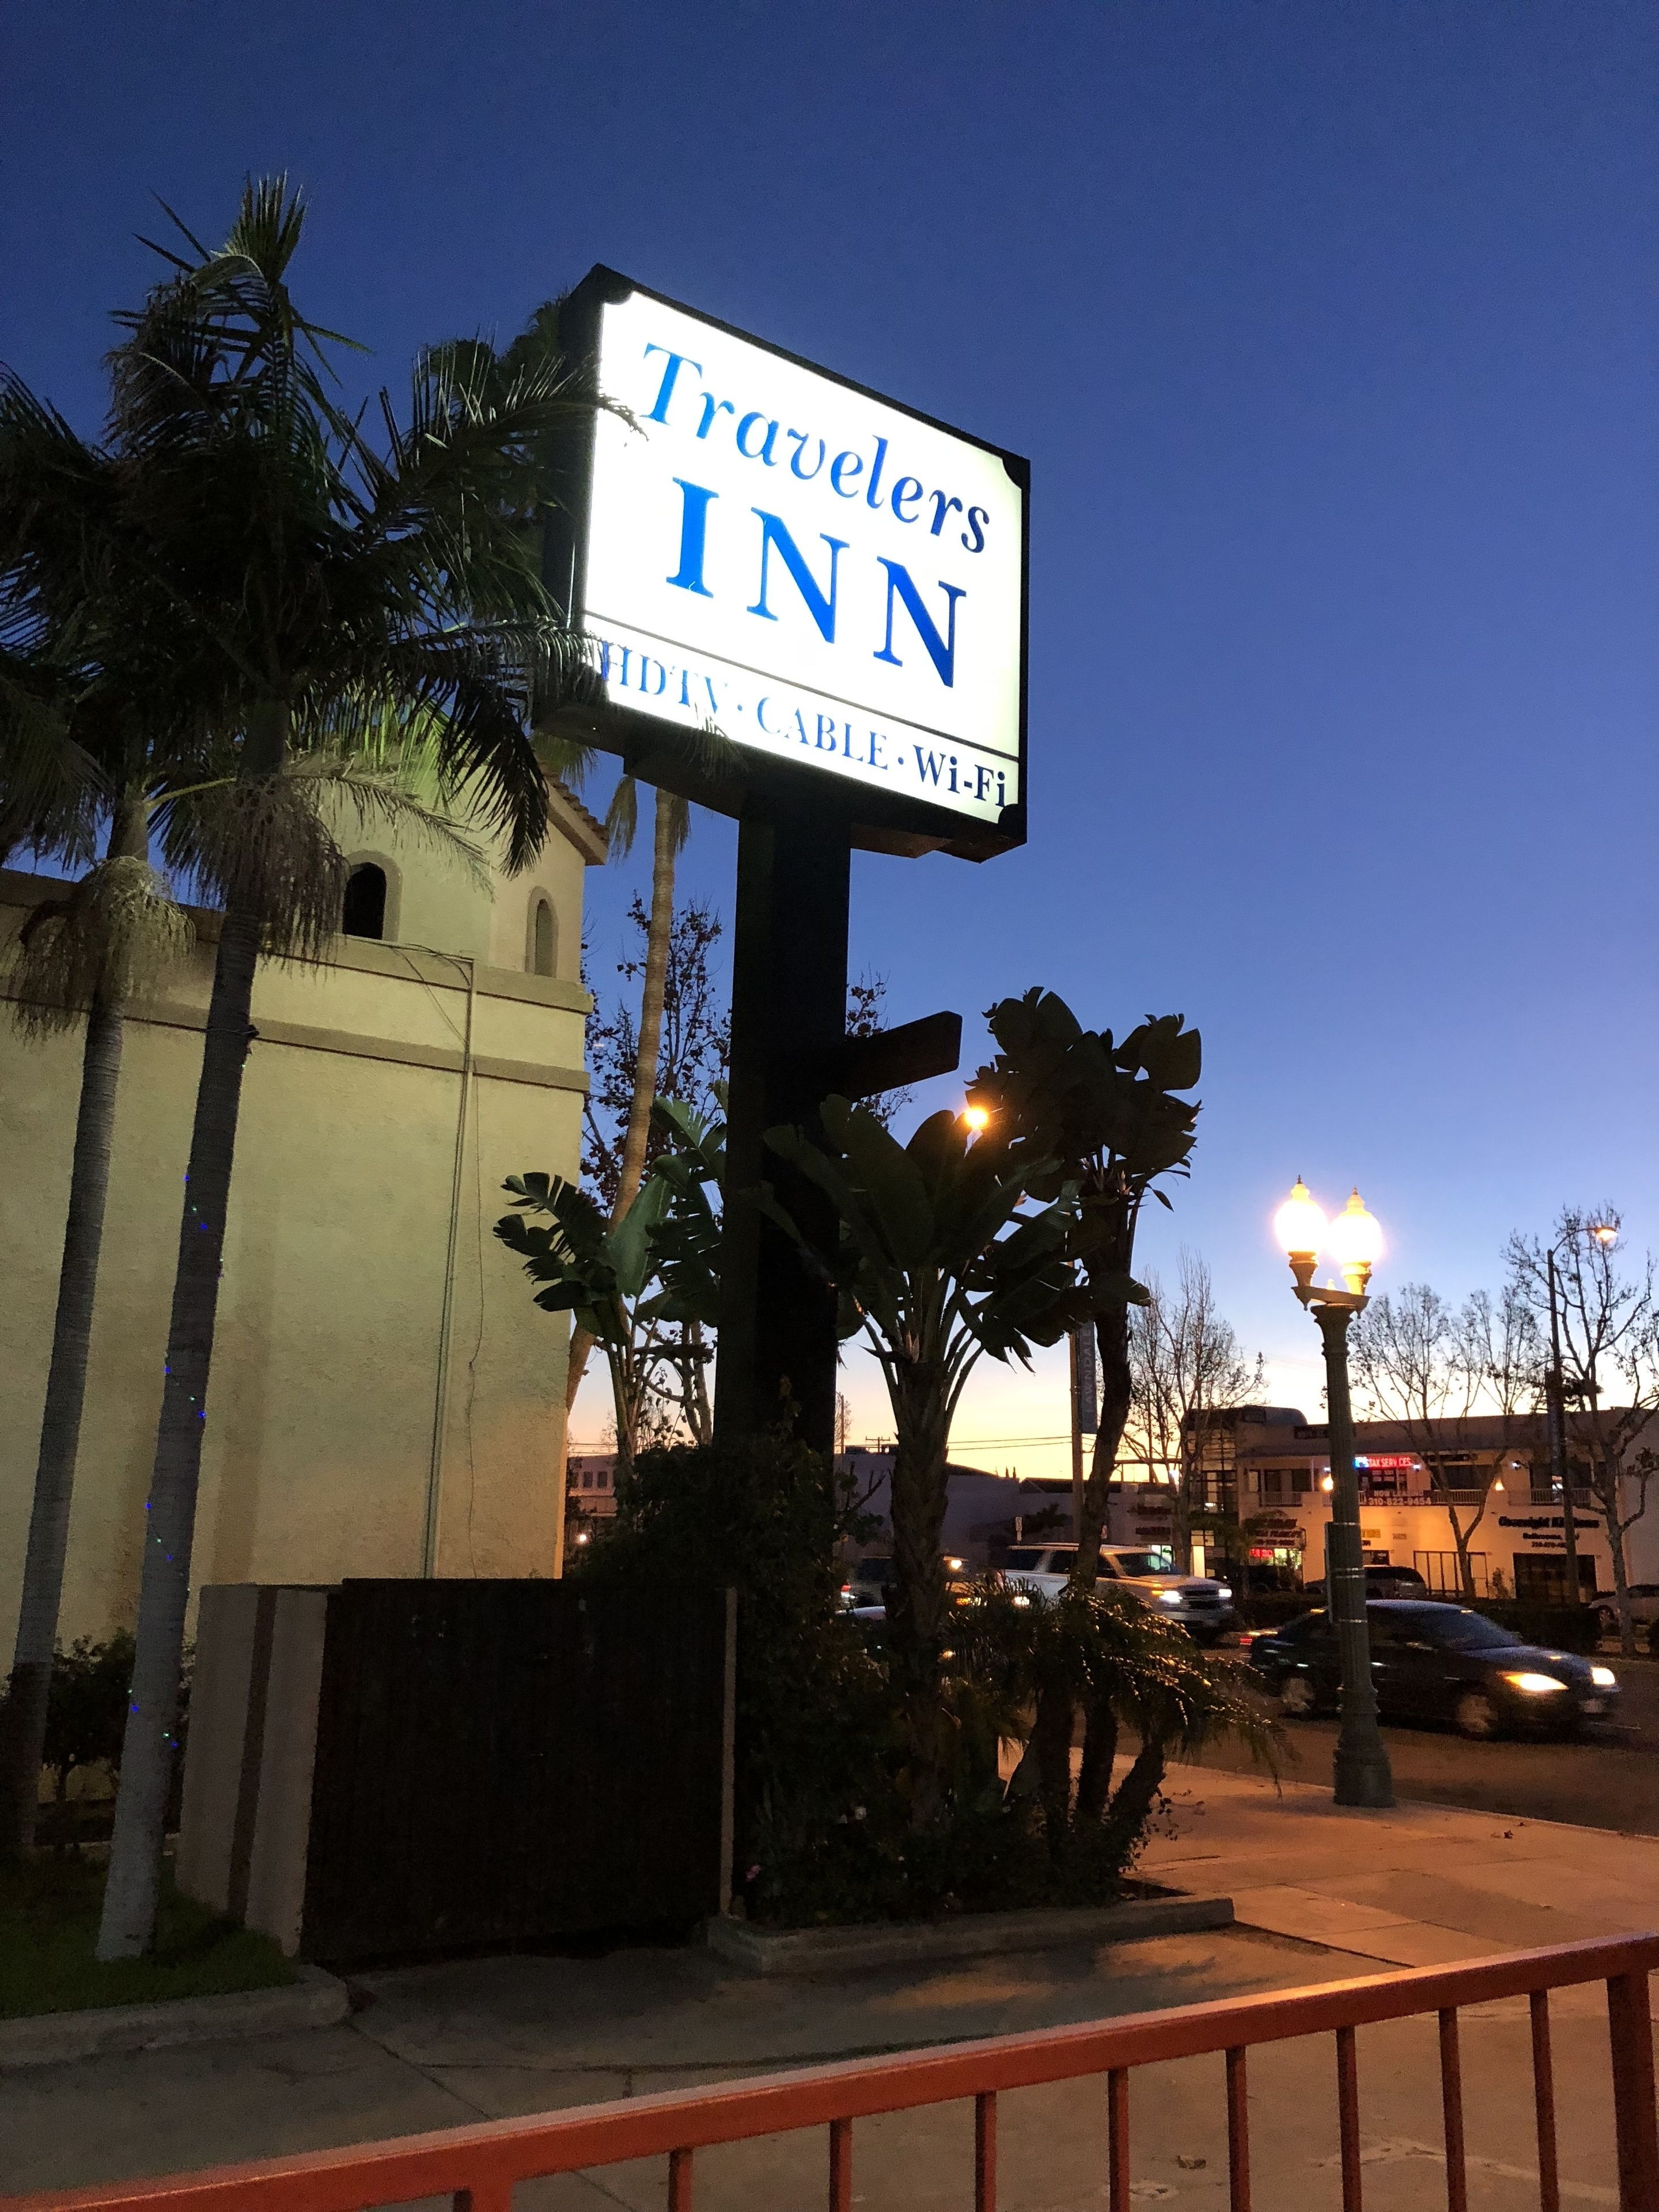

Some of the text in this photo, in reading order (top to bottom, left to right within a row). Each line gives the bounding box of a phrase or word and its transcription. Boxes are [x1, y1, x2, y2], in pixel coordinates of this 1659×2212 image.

[641, 343, 990, 553] Travelers
[666, 478, 967, 688] INN
[601, 641, 1009, 808] HDTV CABLE Wi-Fi
[1381, 1457, 1412, 1467] SERVCES
